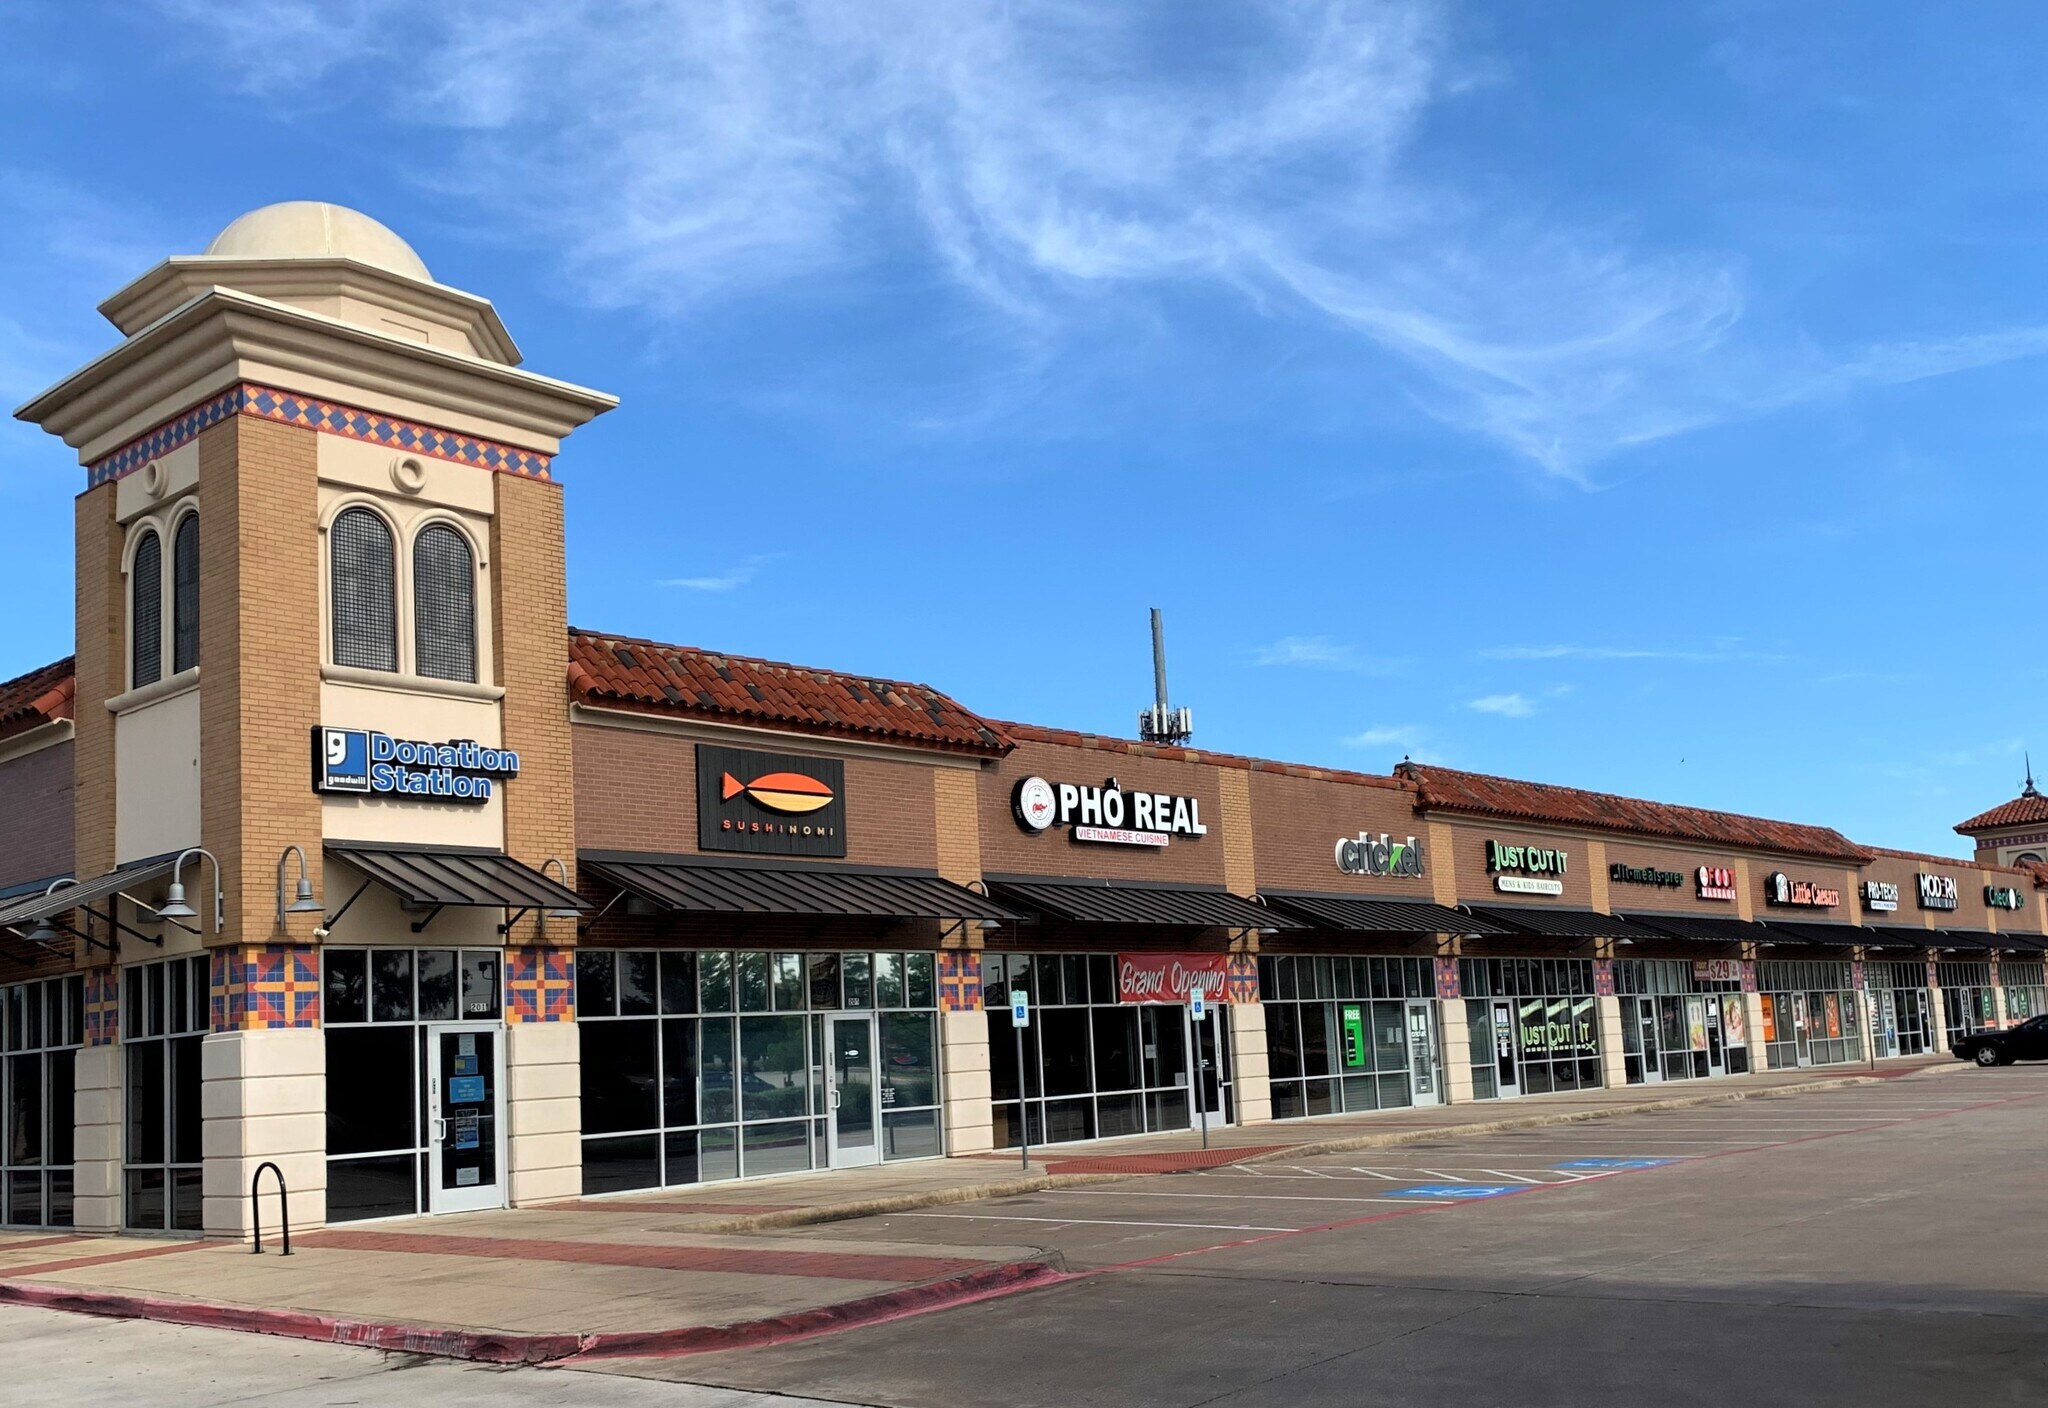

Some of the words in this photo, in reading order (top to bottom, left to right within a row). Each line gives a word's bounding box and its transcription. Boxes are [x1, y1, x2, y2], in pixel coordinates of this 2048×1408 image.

[371, 733, 520, 771] Donation
[328, 776, 366, 785] goodwill
[371, 763, 492, 798] Station
[1134, 792, 1207, 834] REAL
[722, 819, 834, 836] SUSHINOMI
[1077, 828, 1134, 842] VIETNAMESE
[1135, 833, 1168, 845] CUISINE
[1336, 832, 1425, 878] cricket
[1701, 887, 1737, 900] MASSAGE
[1789, 881, 1811, 904] Little
[1811, 883, 1840, 906] Caesars
[1920, 873, 1958, 899] MODERN
[1119, 962, 1165, 996] Grand
[1170, 960, 1226, 997] Opening
[1710, 960, 1730, 979] $29
[1344, 1009, 1360, 1020] FREE
